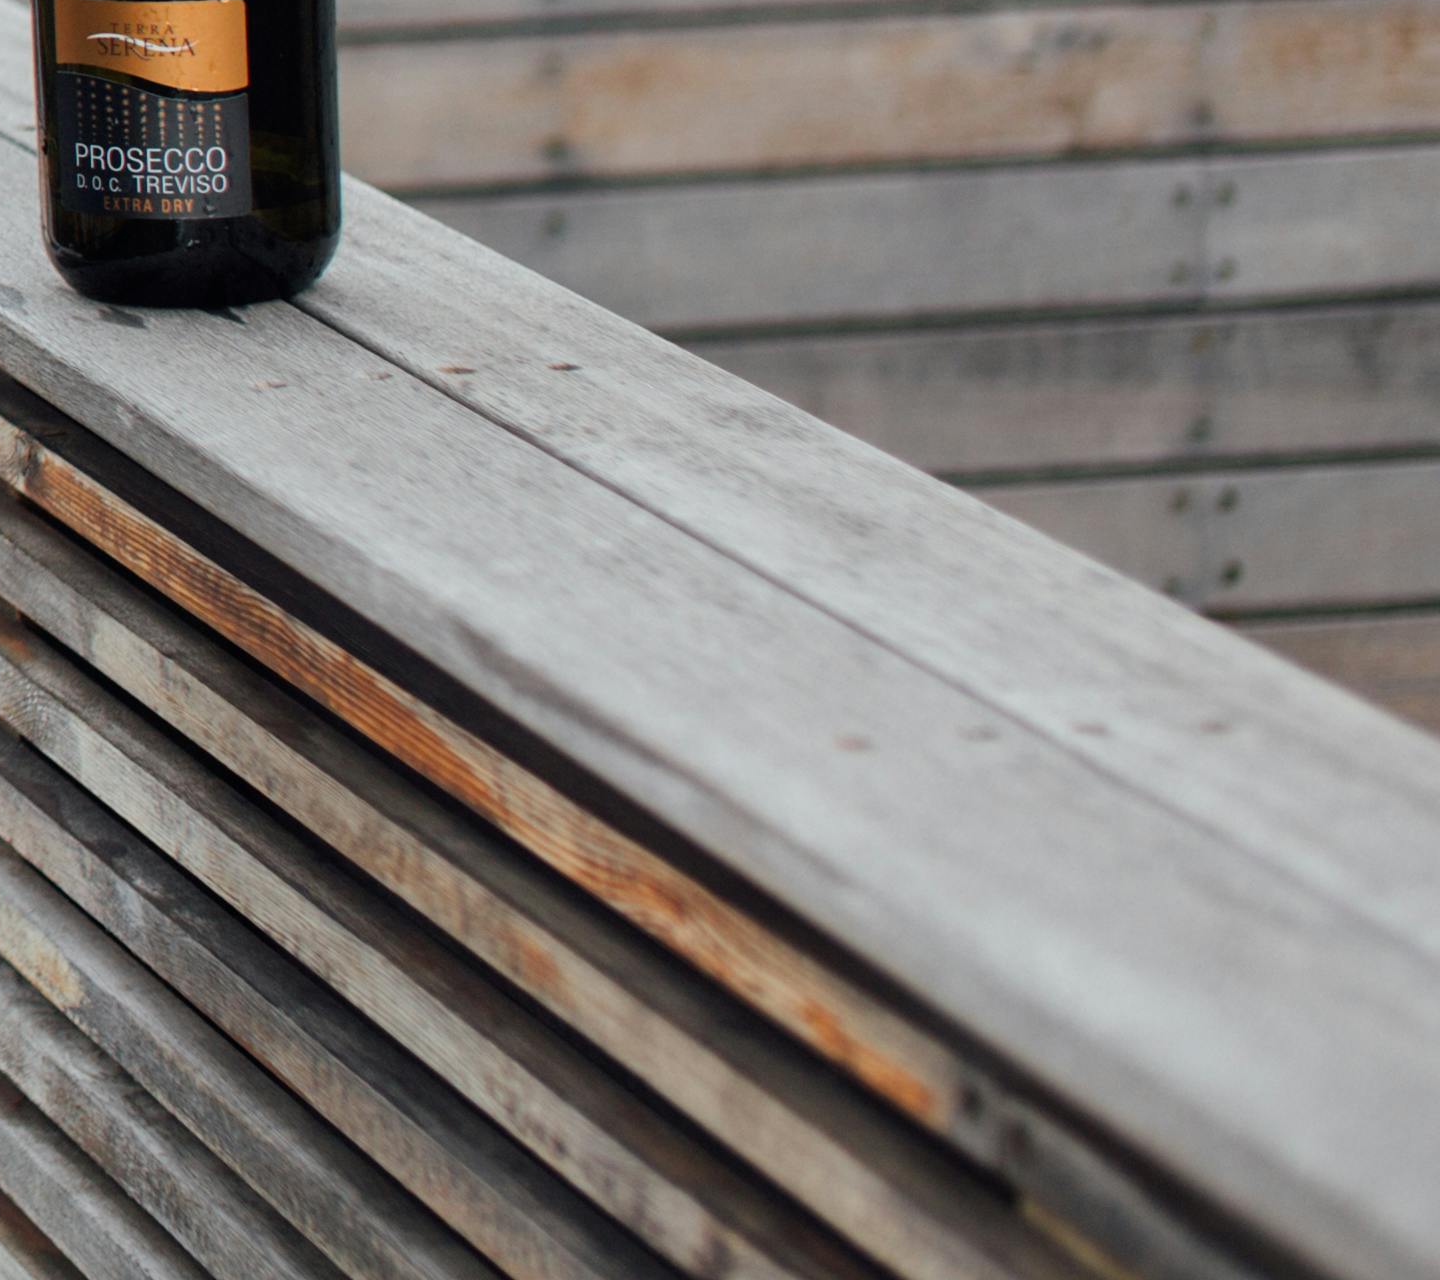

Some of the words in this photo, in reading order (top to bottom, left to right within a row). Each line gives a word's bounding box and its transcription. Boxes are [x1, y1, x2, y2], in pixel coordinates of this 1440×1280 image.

[110, 22, 175, 35] TERRA
[96, 37, 196, 60] SERENA
[75, 142, 226, 173] PROSECCO
[132, 174, 228, 194] TREVISO
[103, 195, 153, 213] EXTRA
[161, 198, 194, 214] DRY
